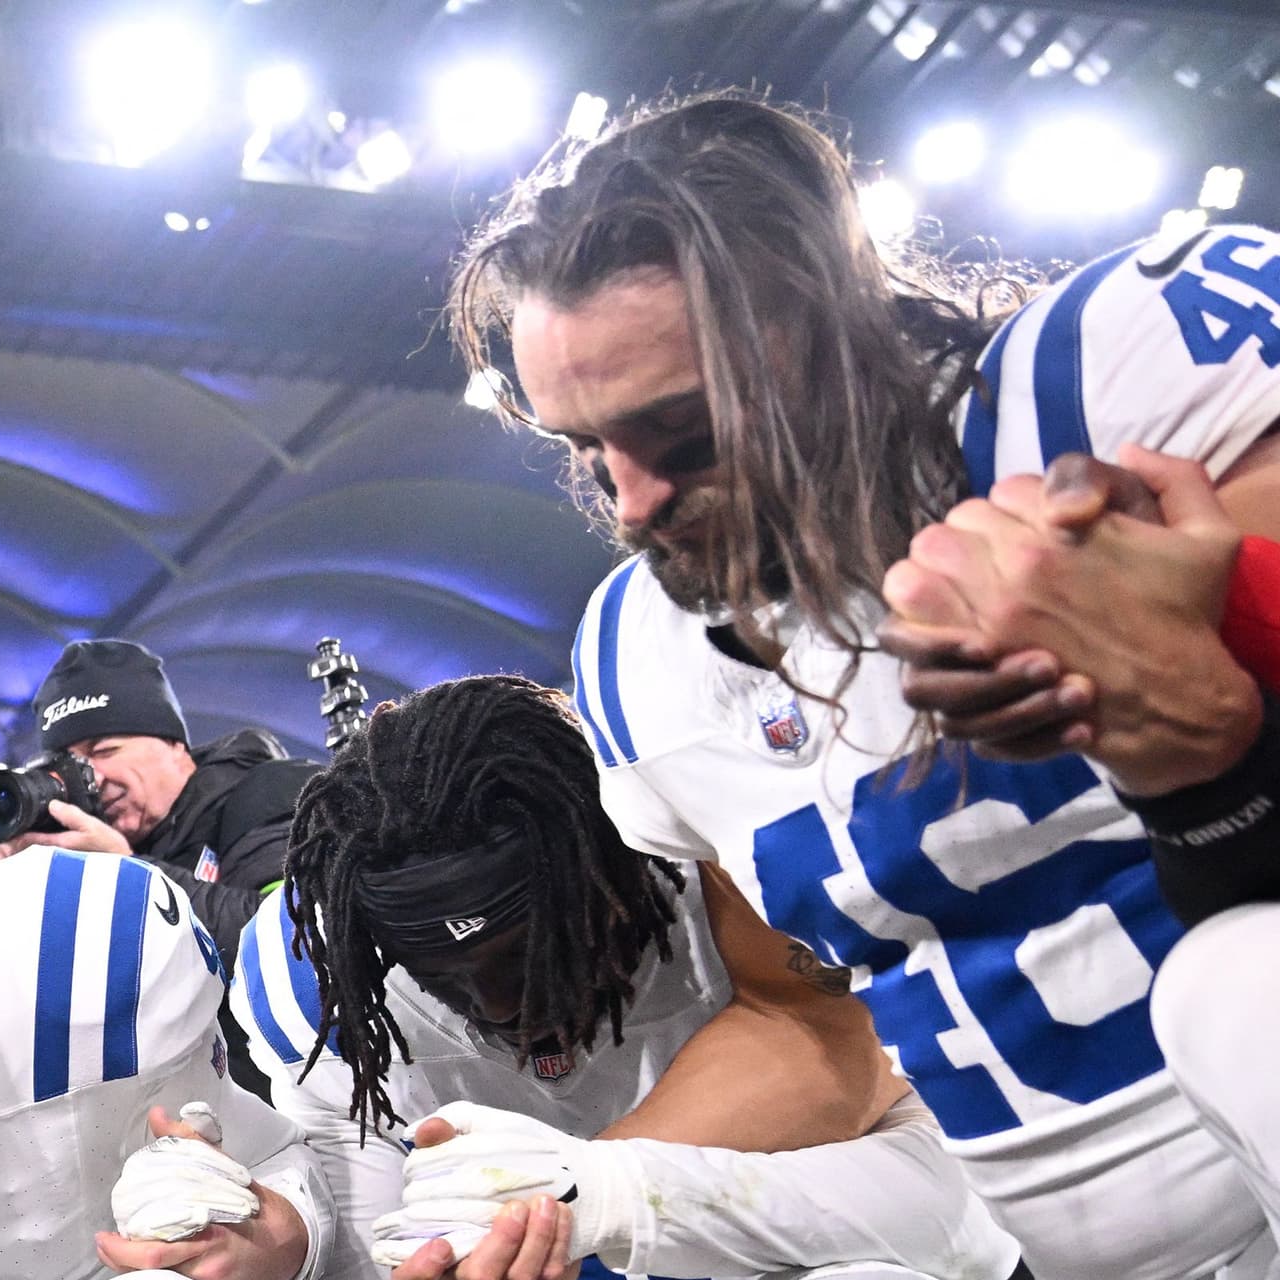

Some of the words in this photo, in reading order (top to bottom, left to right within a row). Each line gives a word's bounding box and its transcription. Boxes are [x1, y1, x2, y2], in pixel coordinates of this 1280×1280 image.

[41, 693, 110, 731] Titleist
[767, 718, 801, 746] NFL
[538, 1055, 570, 1077] NFL
